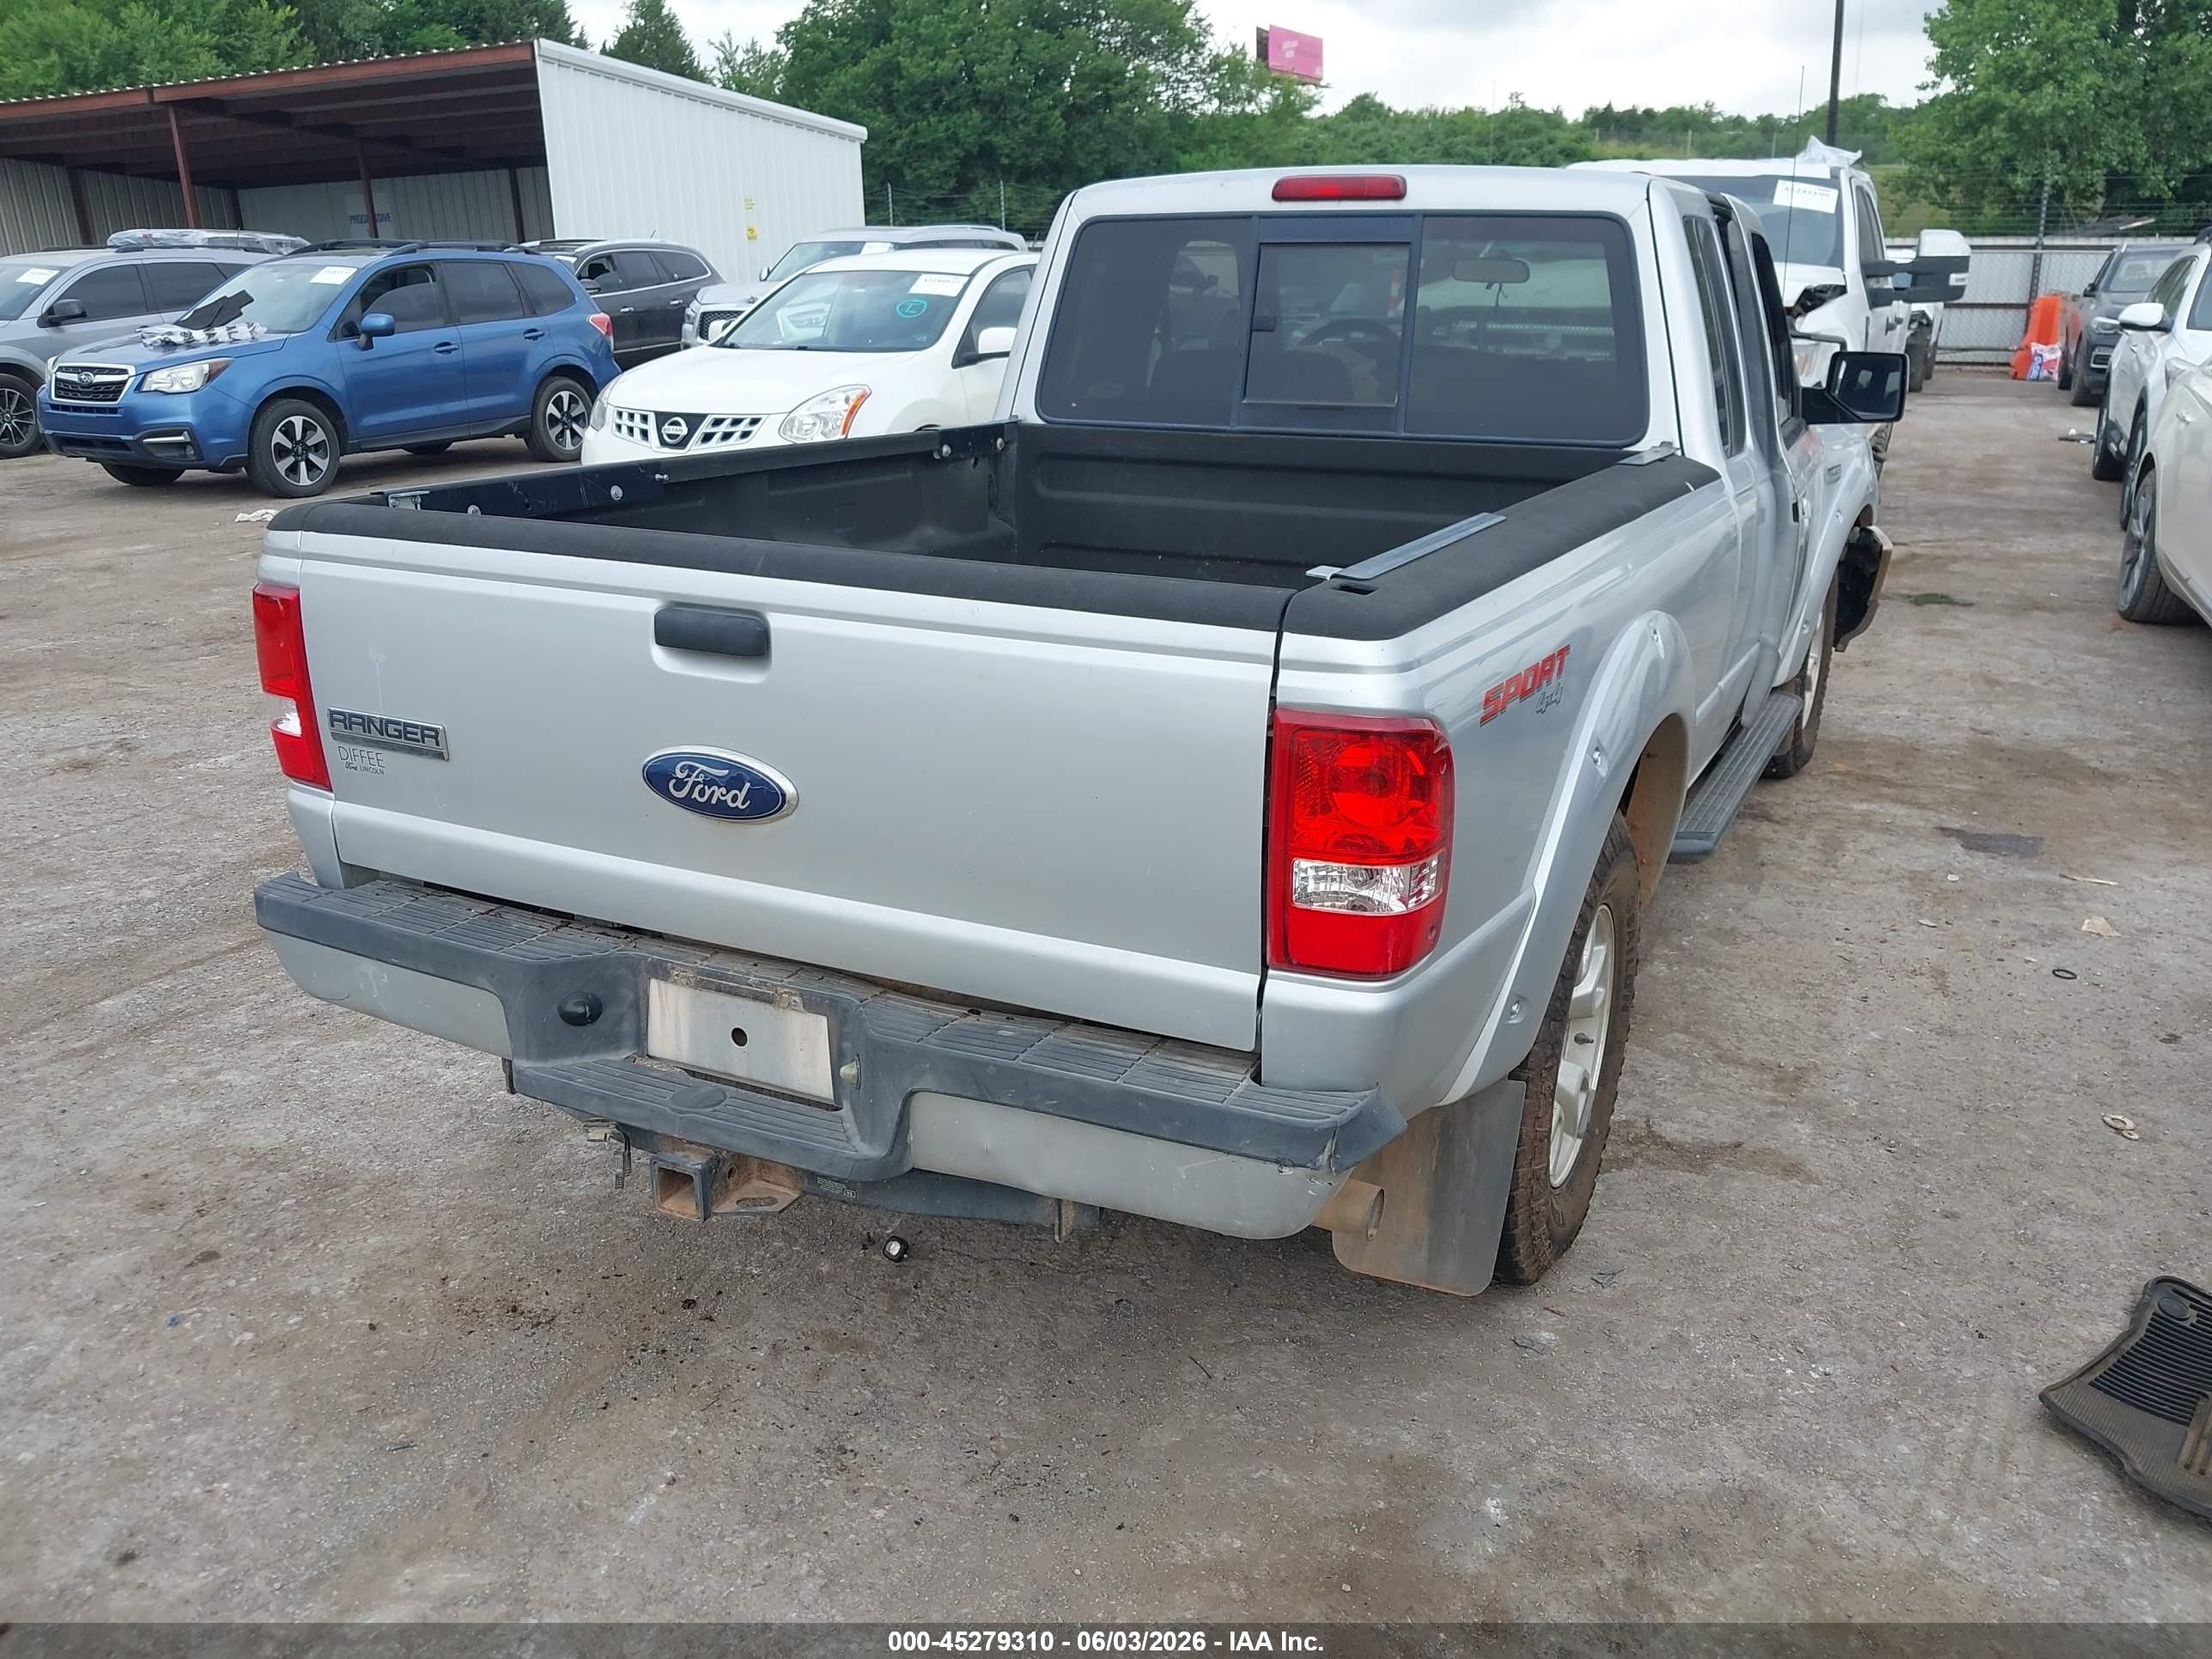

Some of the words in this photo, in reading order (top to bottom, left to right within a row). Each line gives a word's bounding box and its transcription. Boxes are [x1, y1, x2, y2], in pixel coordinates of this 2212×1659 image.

[1480, 644, 1571, 727] SPORT
[1535, 683, 1564, 714] 4x4
[329, 710, 441, 747] RANGER
[337, 745, 386, 769] DIFFEE
[360, 764, 385, 775] LINCOLN
[668, 760, 751, 810] Ford
